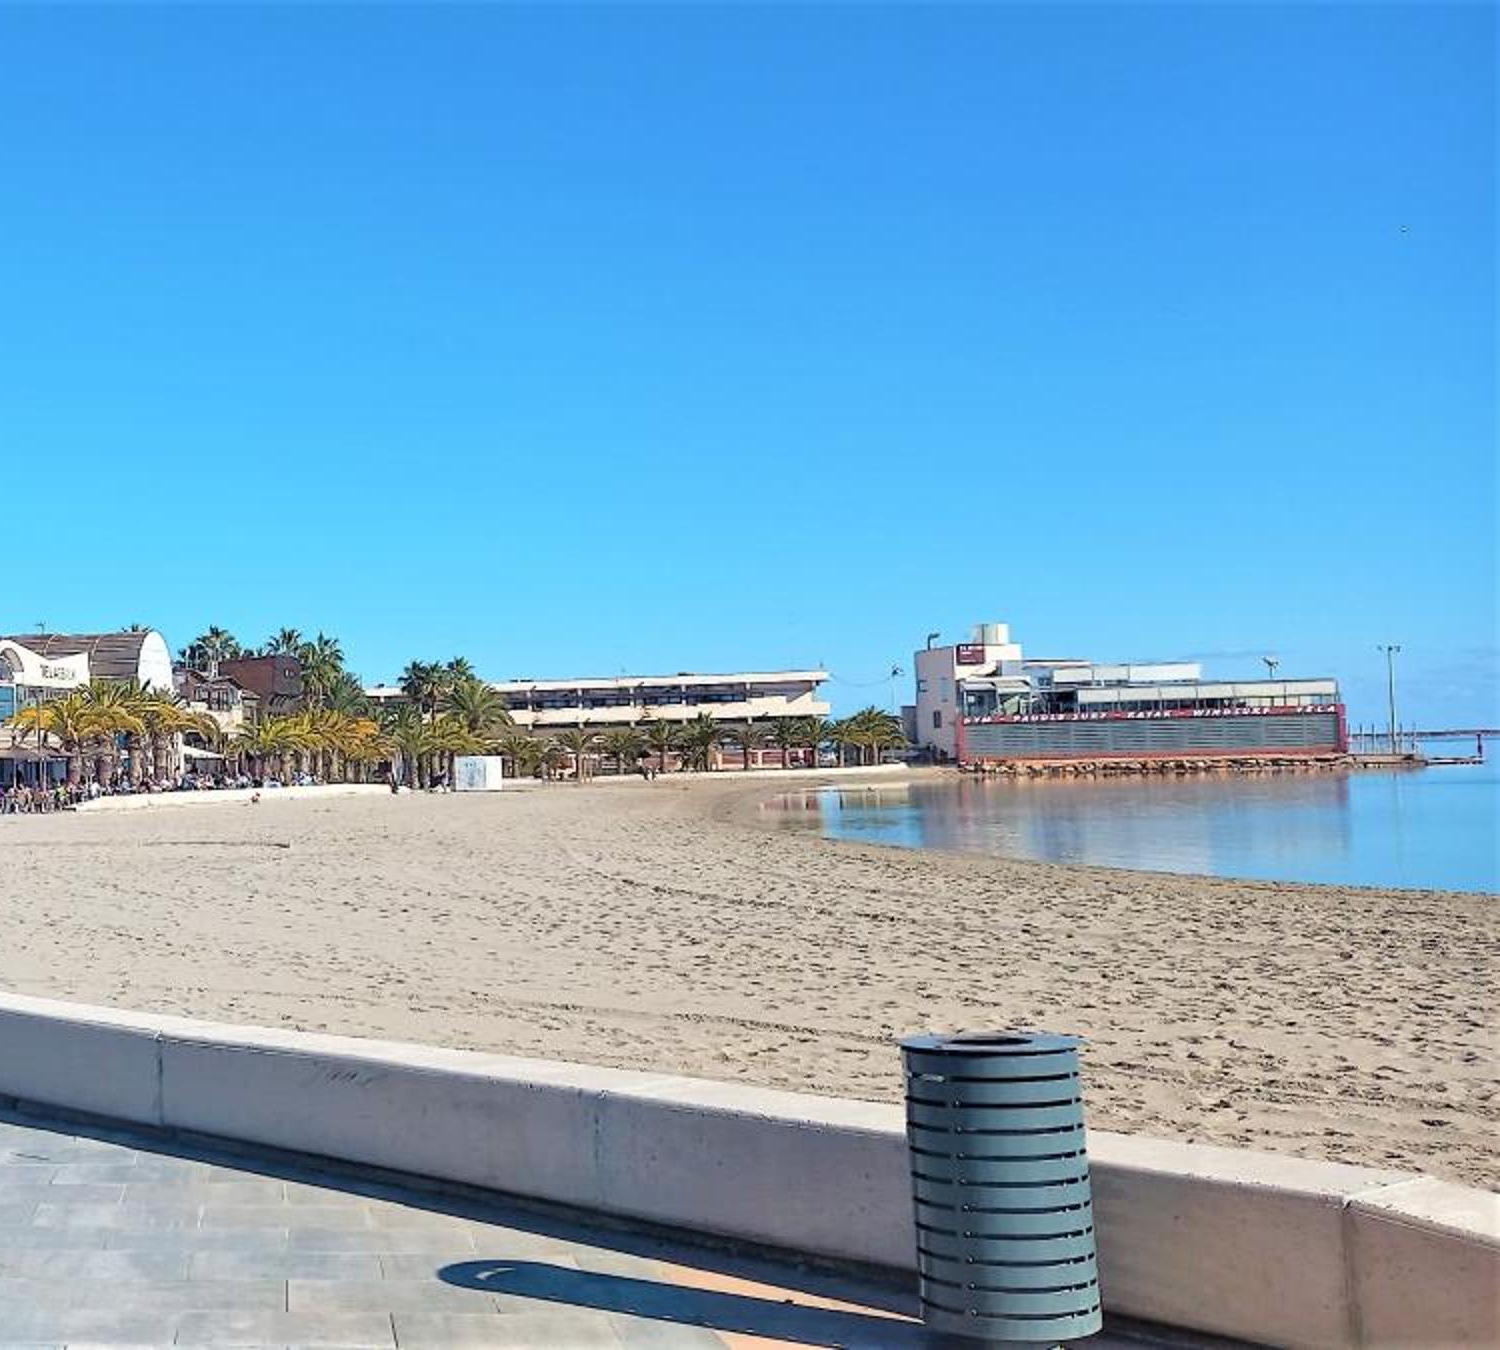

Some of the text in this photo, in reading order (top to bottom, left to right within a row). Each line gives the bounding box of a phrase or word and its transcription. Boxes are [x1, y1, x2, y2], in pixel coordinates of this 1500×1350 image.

[1012, 713, 1065, 722] PADDLE
[1071, 711, 1109, 721] SURF
[1127, 710, 1172, 719] KAYAK
[1193, 707, 1270, 717] WINDSURF
[1296, 704, 1336, 713] VELA
